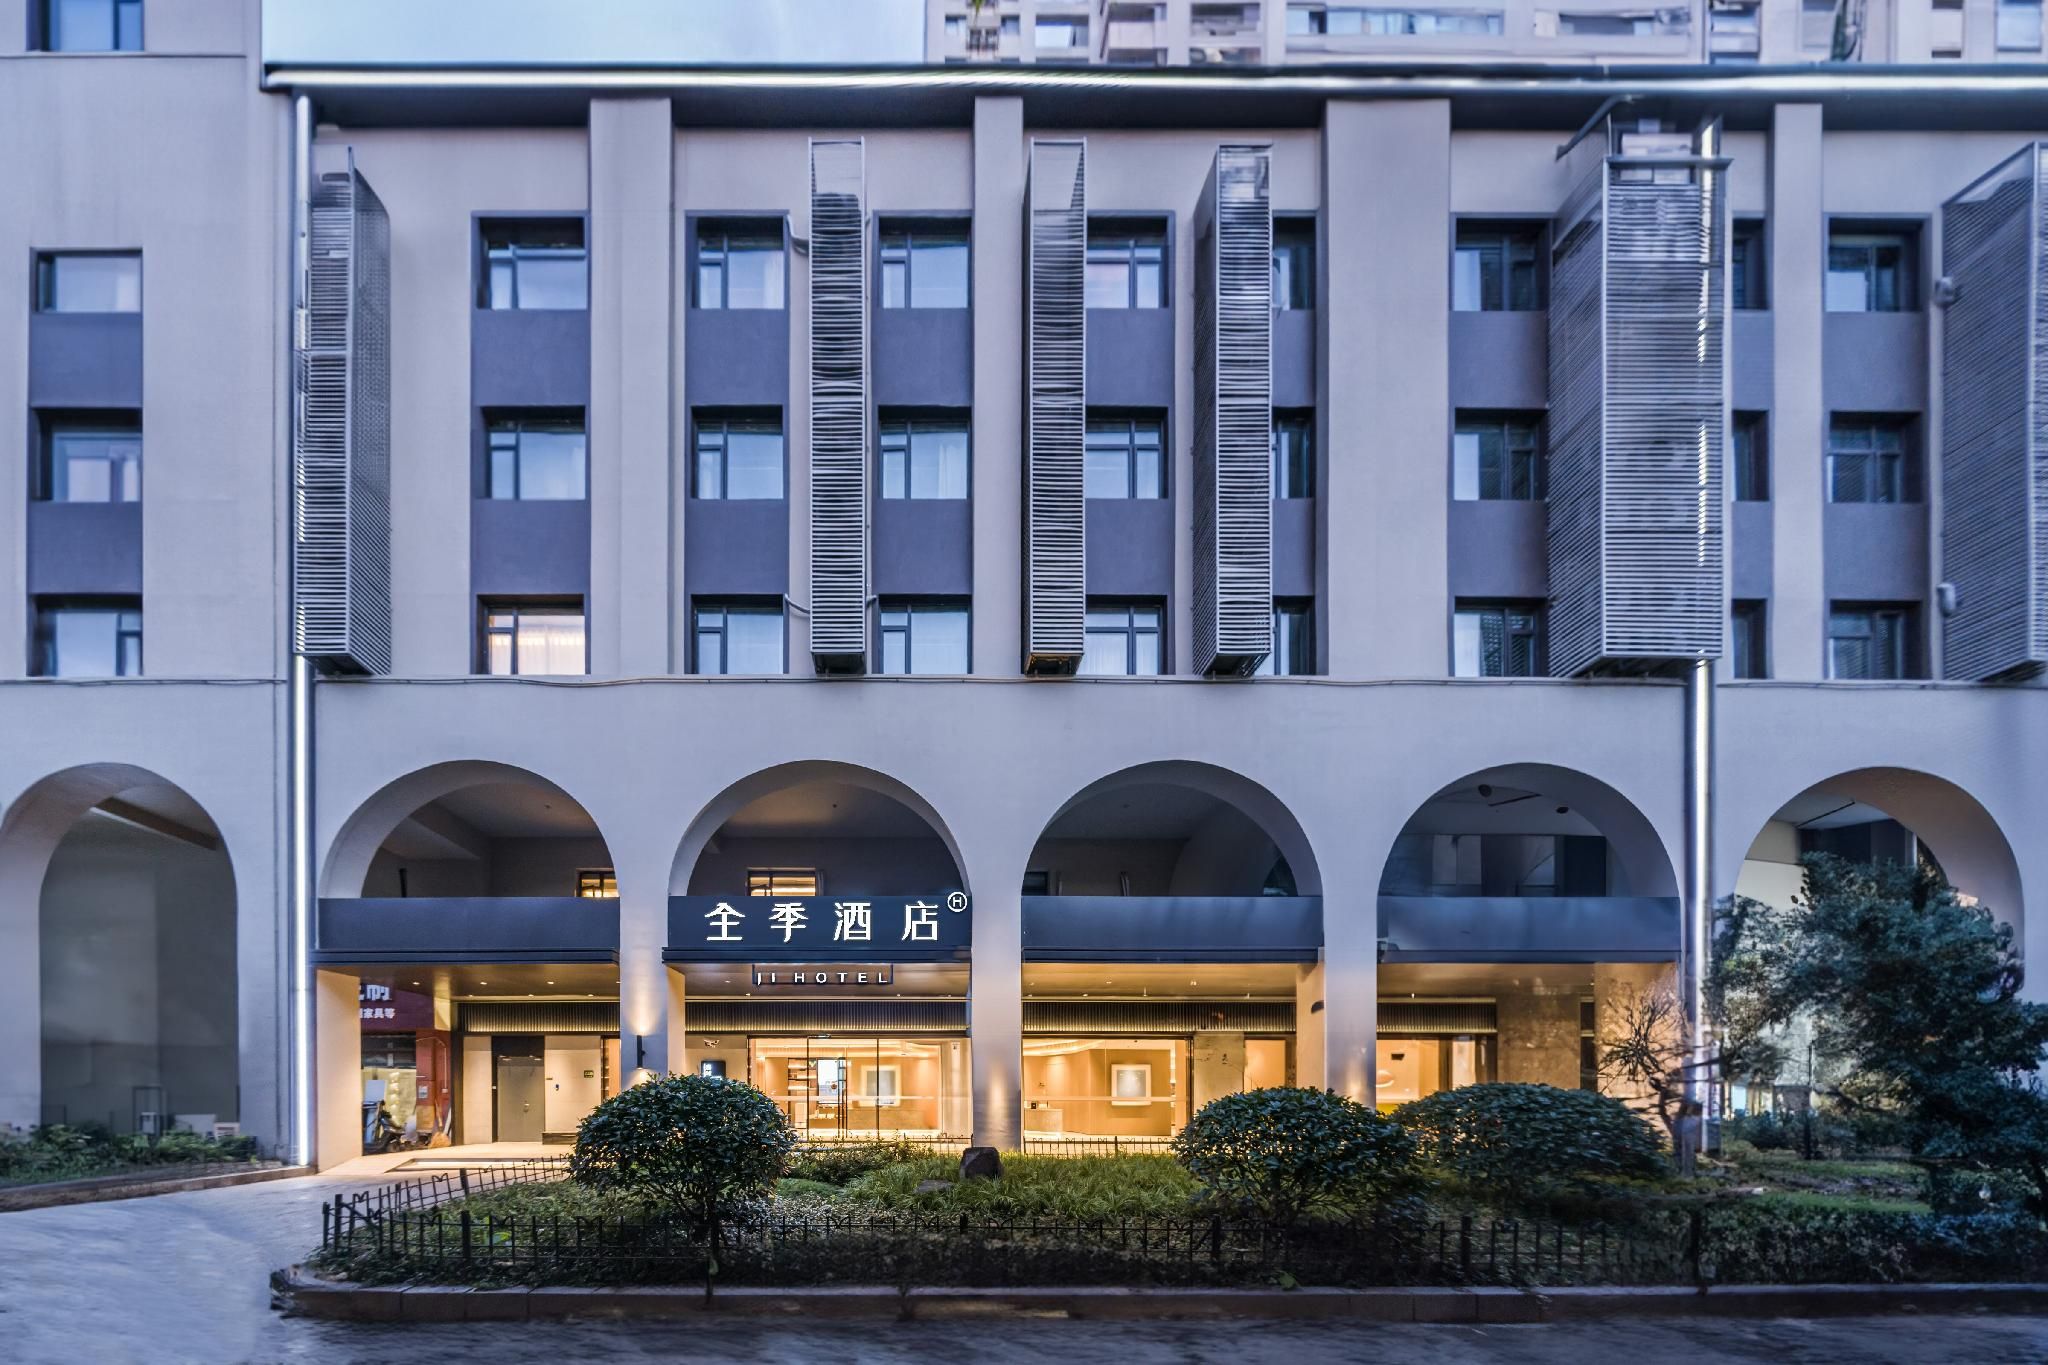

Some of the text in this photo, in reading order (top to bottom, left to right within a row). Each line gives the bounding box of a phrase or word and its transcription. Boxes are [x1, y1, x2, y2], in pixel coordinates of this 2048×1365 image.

[704, 901, 939, 942] 全季酒店
[757, 972, 888, 985] JI HOTEL
[360, 1007, 395, 1019] 家具等
